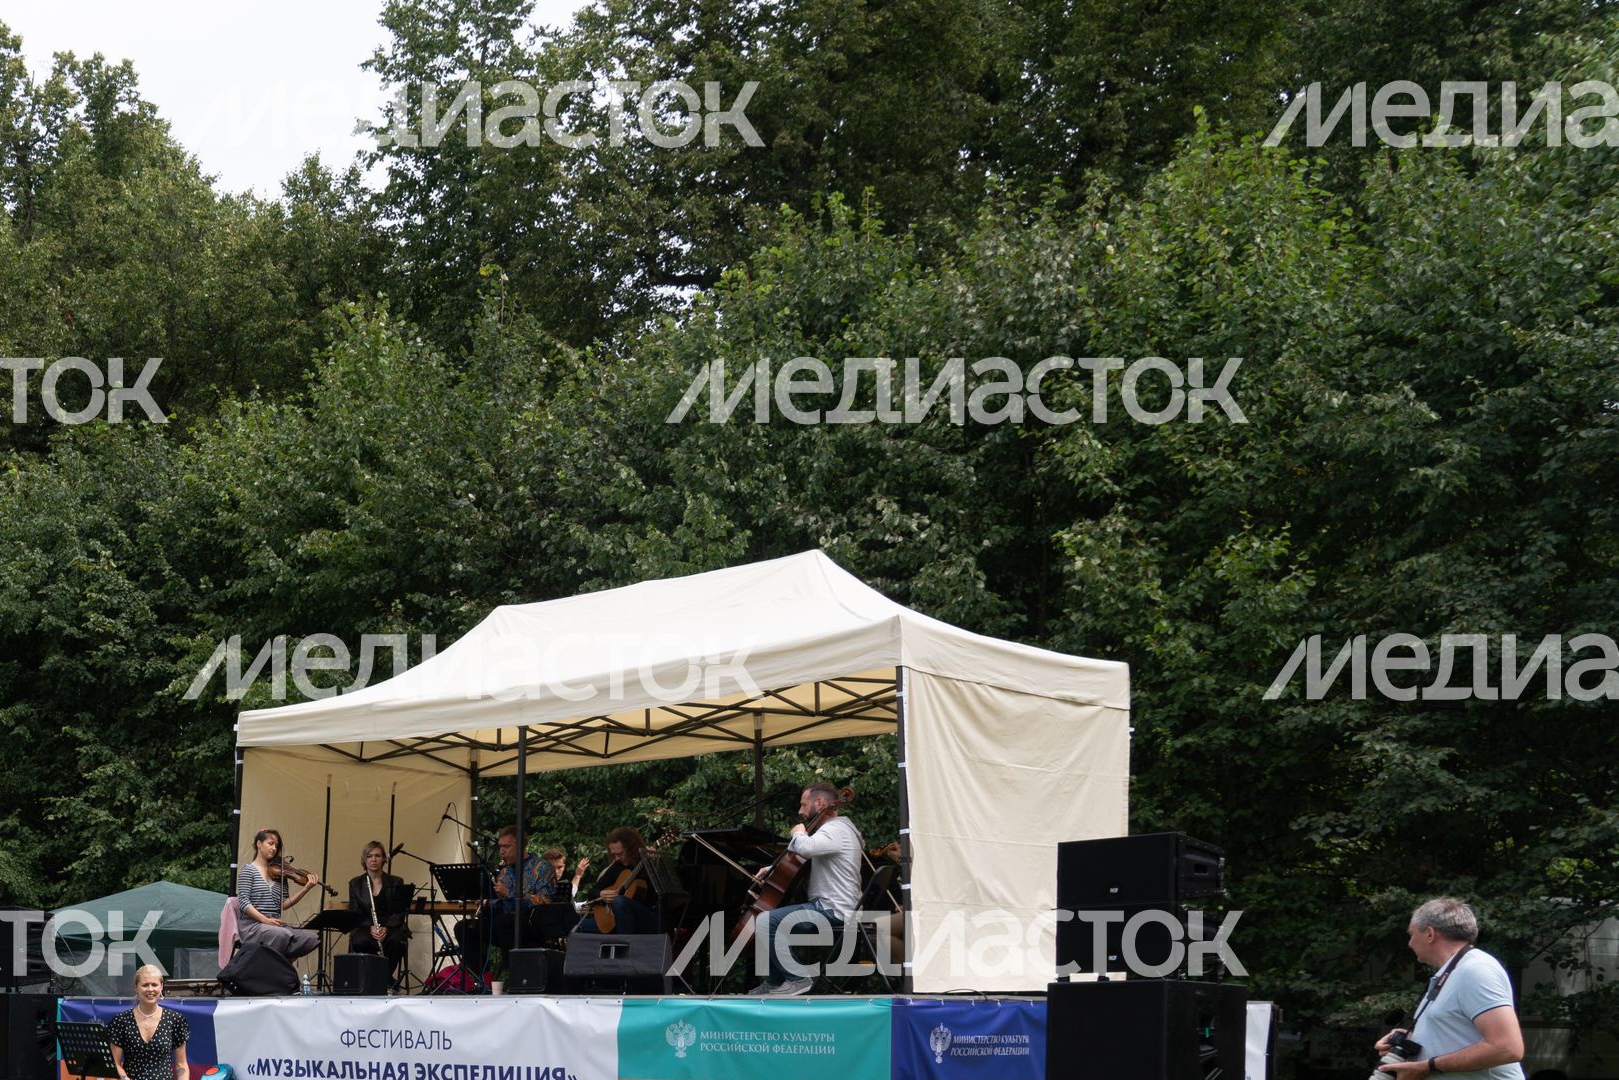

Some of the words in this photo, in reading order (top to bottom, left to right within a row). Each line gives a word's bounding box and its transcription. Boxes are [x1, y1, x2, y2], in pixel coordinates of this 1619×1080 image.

[340, 1028, 452, 1050] ФЕСТИВАЛЬ
[700, 1031, 780, 1041] МИНИСТЕРСТВО
[783, 1032, 835, 1042] КУЛЬТУРЫ
[700, 1042, 769, 1053] РОССИЙСКОЙ
[772, 1043, 835, 1055] ФЕДЕРАЦИИ
[247, 1058, 409, 1080] «МУЗЫКАЛЬНАЯ
